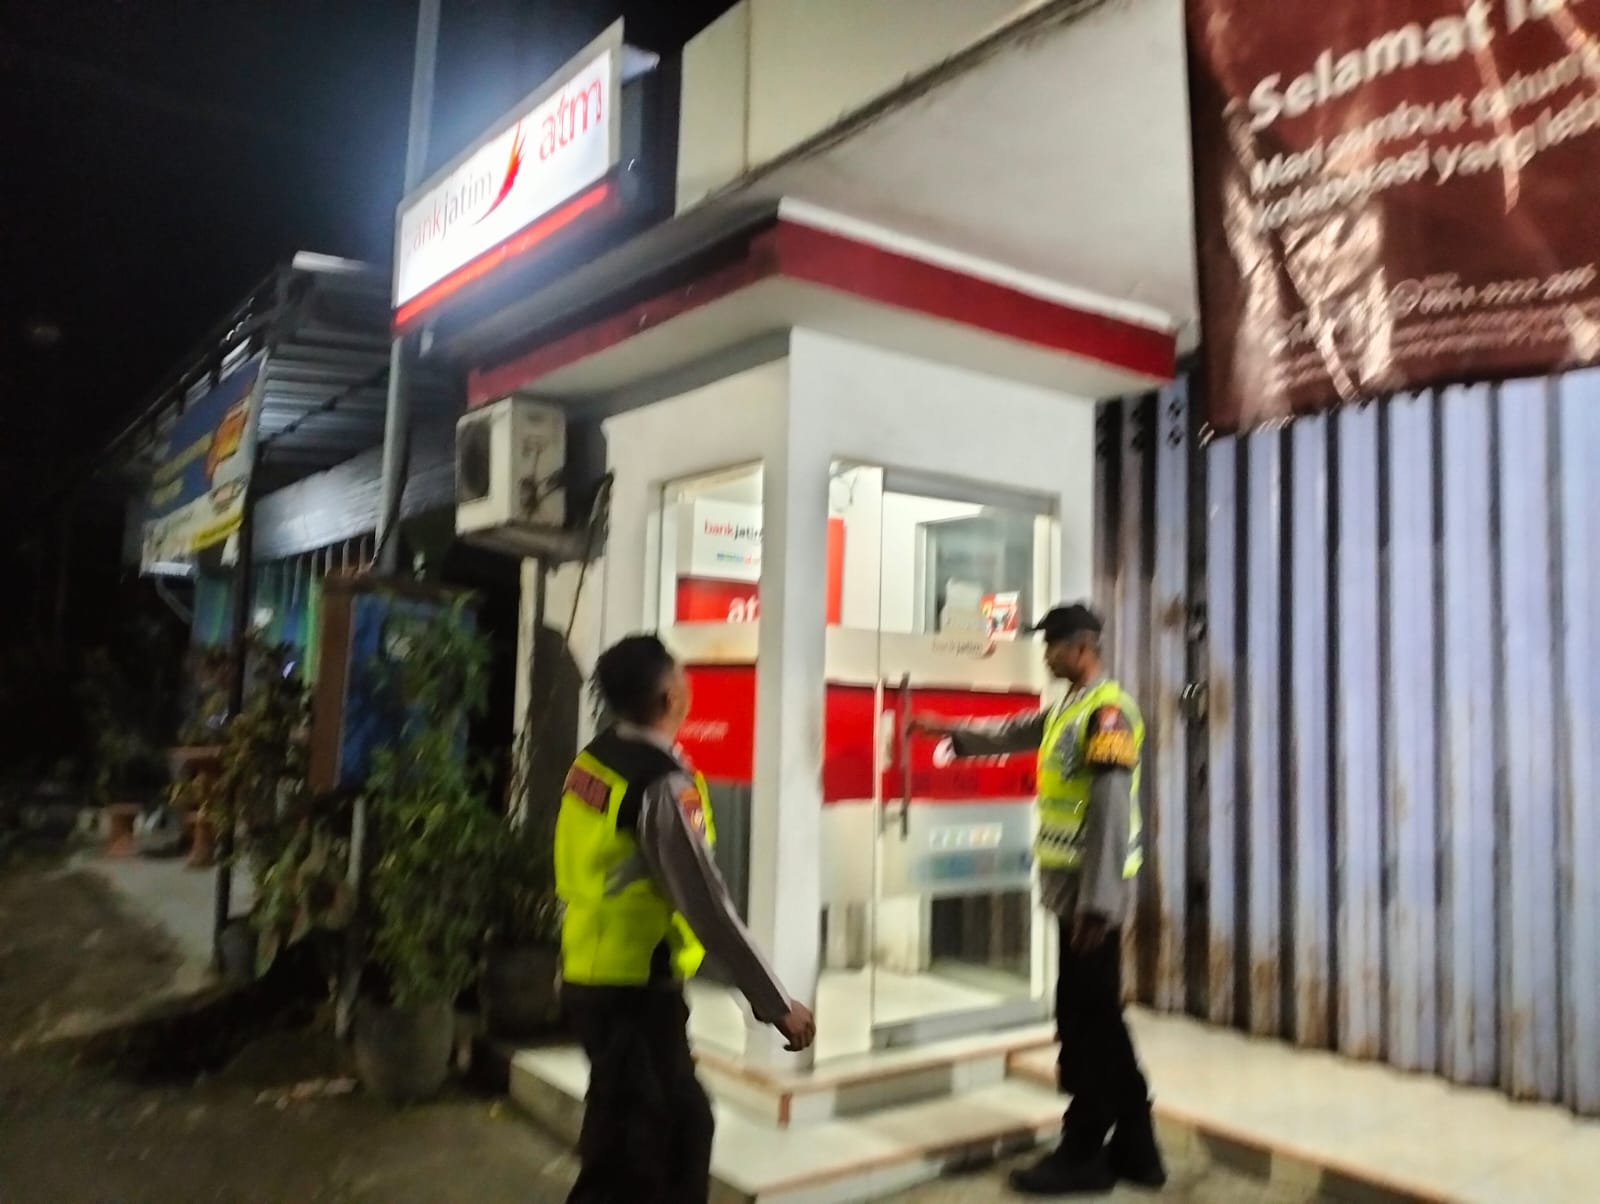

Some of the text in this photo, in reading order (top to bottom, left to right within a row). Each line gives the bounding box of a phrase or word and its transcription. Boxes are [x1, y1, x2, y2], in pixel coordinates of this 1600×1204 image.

[1248, 0, 1496, 133] Selamat
[408, 78, 603, 252] ankjatim atm
[726, 594, 760, 623] at
